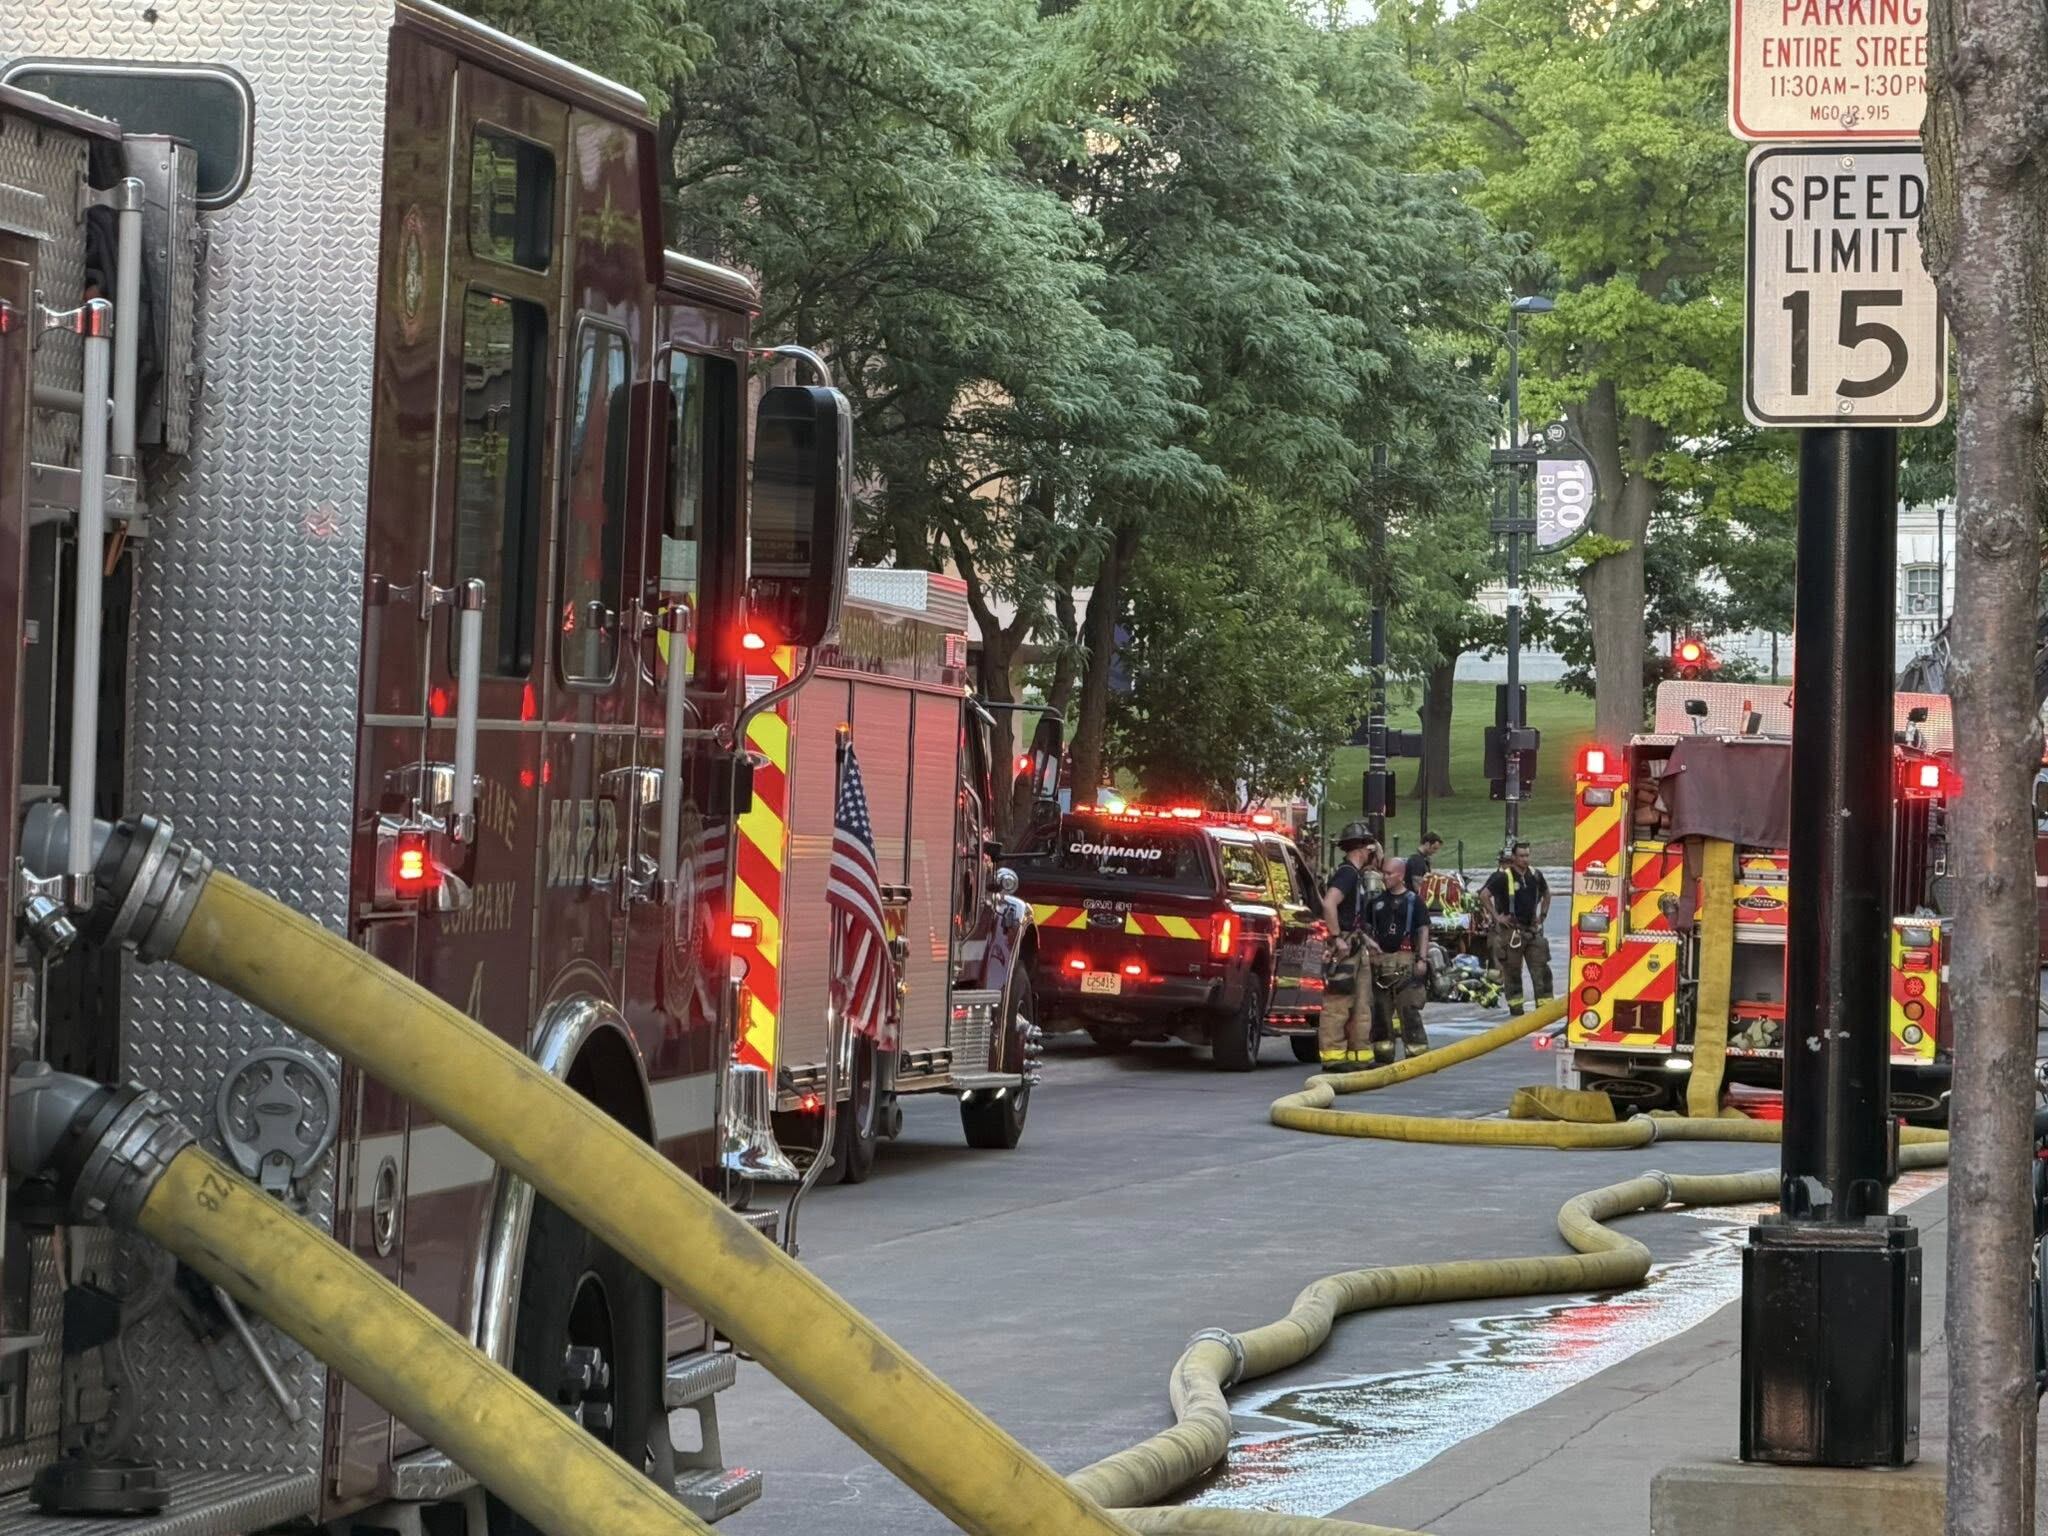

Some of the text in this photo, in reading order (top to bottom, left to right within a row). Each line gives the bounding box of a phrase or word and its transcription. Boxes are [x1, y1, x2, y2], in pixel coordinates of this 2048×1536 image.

[1782, 0, 1922, 26] PARKING
[1762, 36, 1927, 68] ENTIRE STREE
[1810, 106, 1840, 120] MGO
[1769, 175, 1925, 221] SPEED
[1785, 228, 1907, 274] LIMIT
[1782, 289, 1909, 399] 15
[1539, 475, 1556, 529] BLOCK
[1557, 465, 1586, 528] 100
[1070, 843, 1162, 860] COMMAND
[1584, 878, 1611, 891] 77989
[1631, 1004, 1644, 1030] 1
